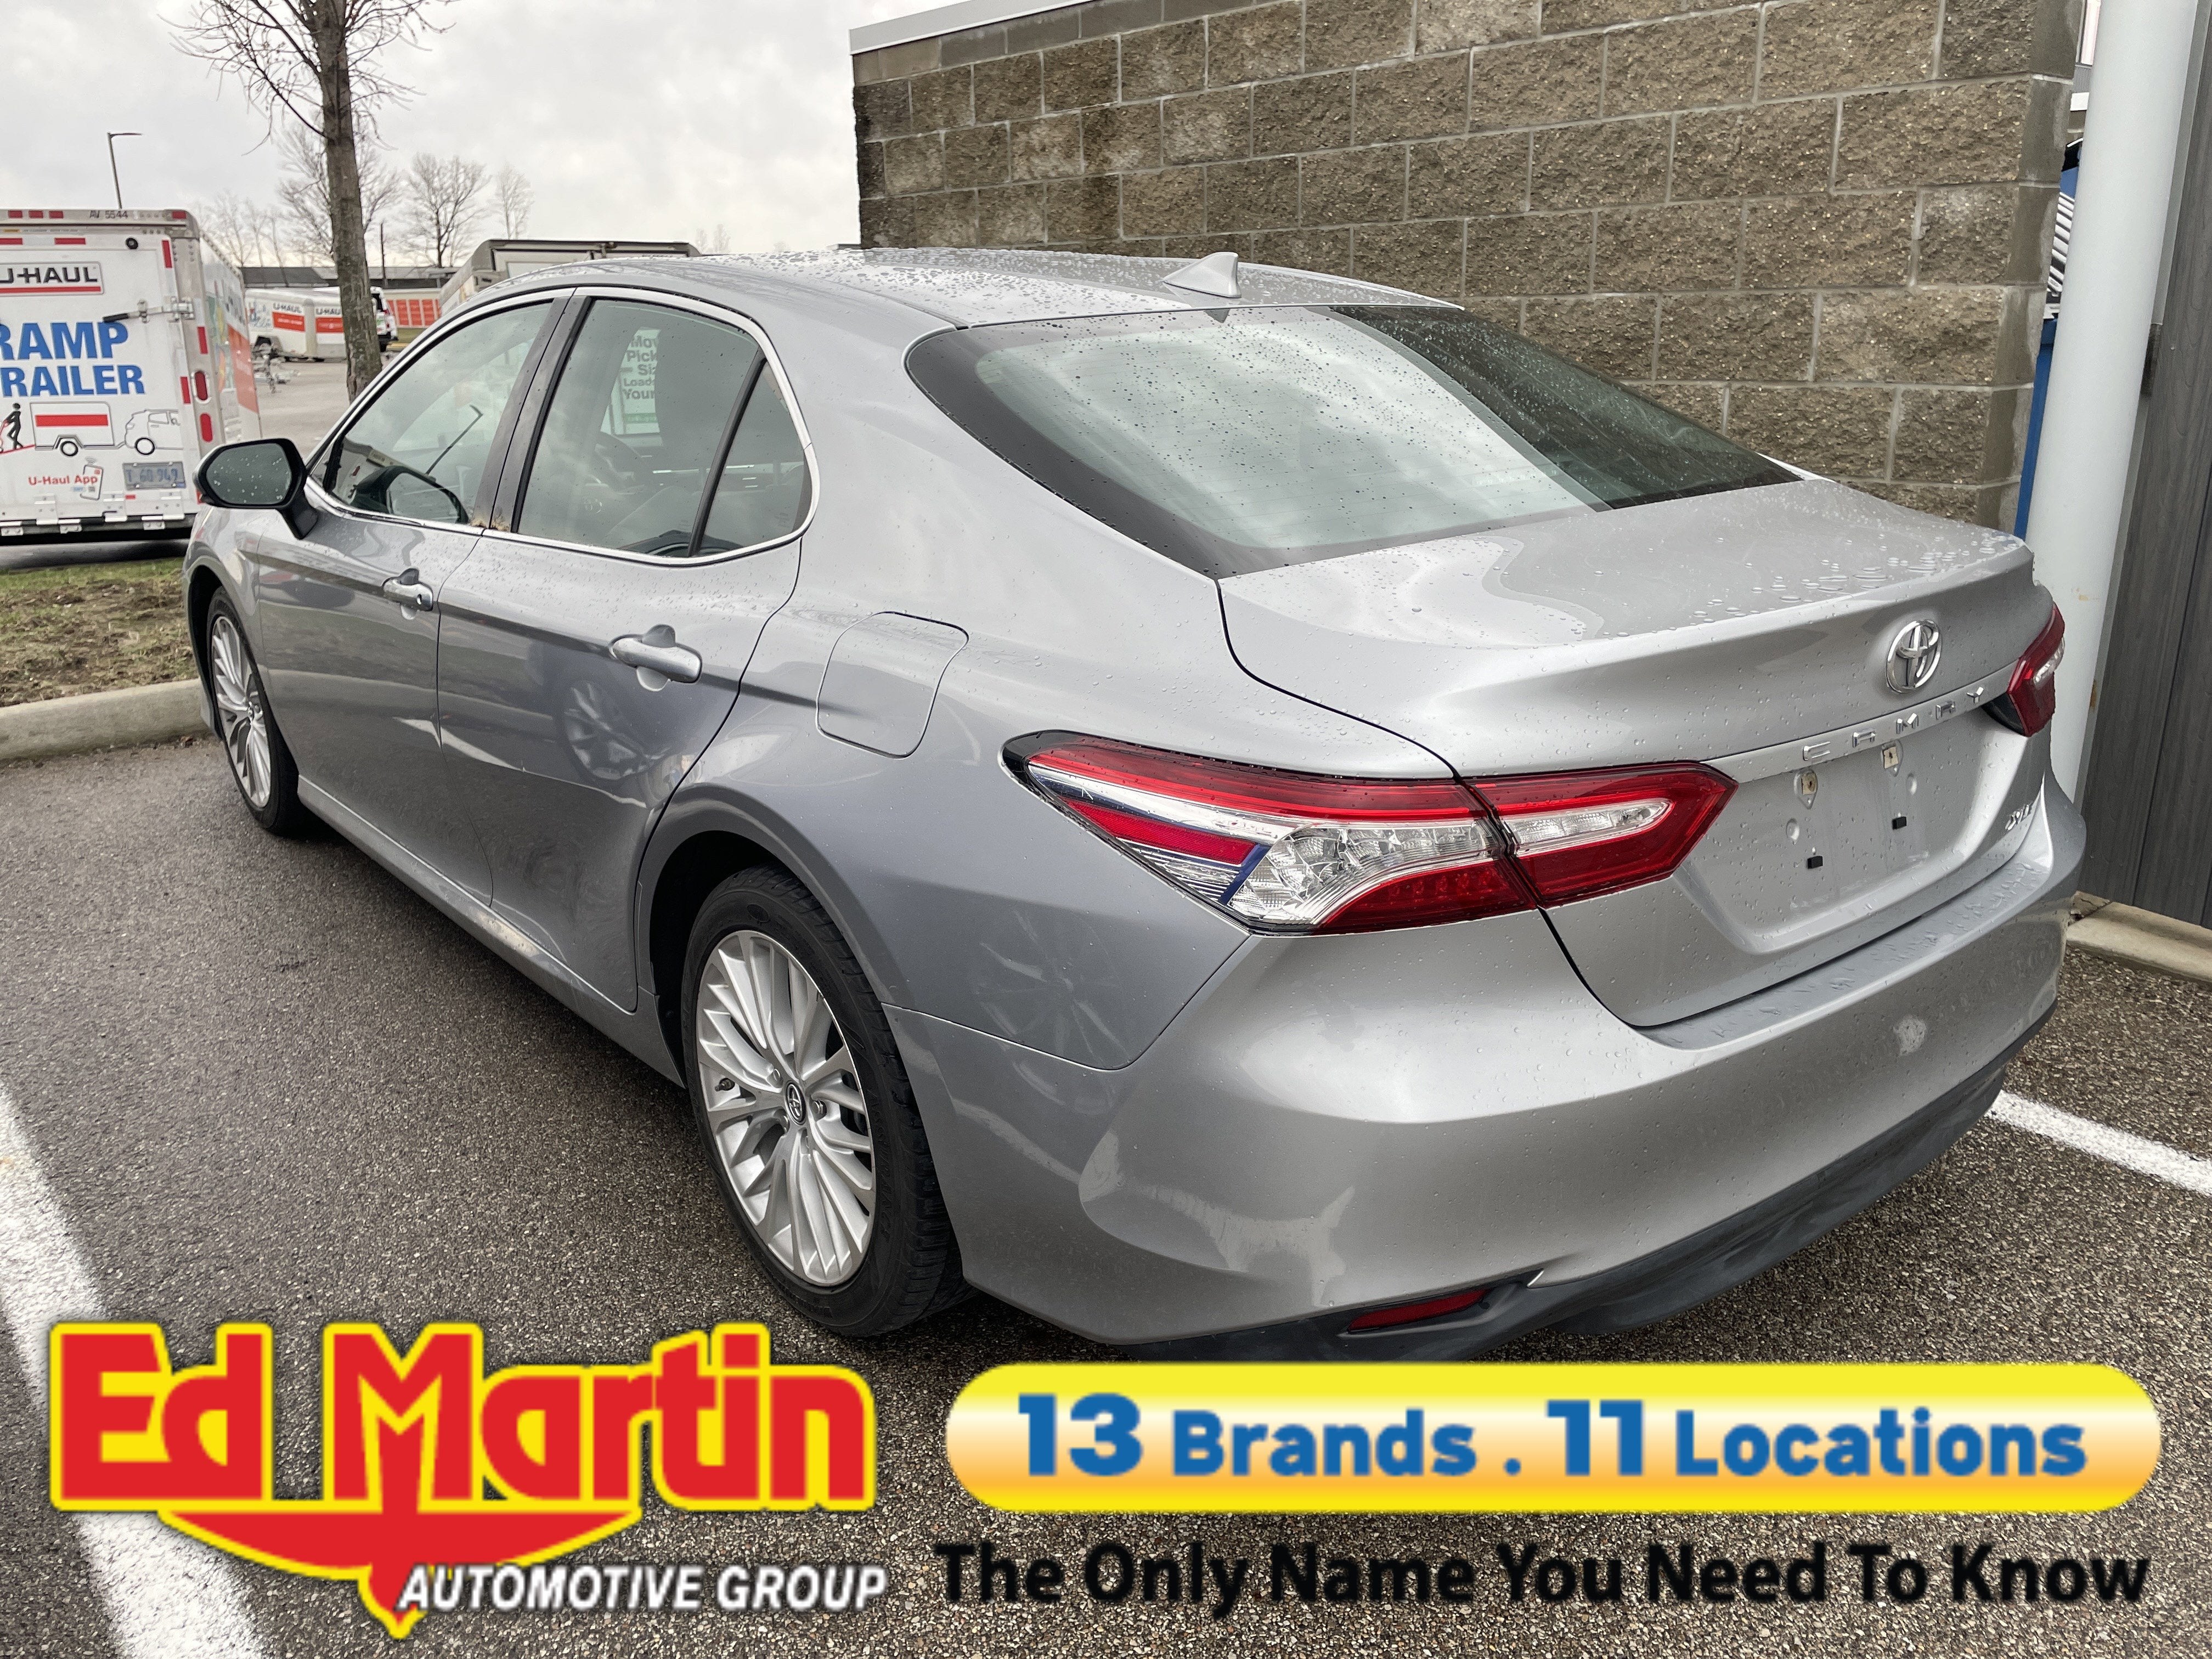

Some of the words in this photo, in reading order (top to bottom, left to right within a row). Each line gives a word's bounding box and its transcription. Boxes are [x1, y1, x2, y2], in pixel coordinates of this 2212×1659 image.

[0, 267, 98, 284] U-HAUL
[637, 364, 655, 376] Si
[0, 365, 145, 397] RAILER
[623, 377, 655, 386] Load
[28, 476, 70, 486] U-Haul
[74, 475, 98, 485] App
[1803, 686, 1984, 761] CAMRY
